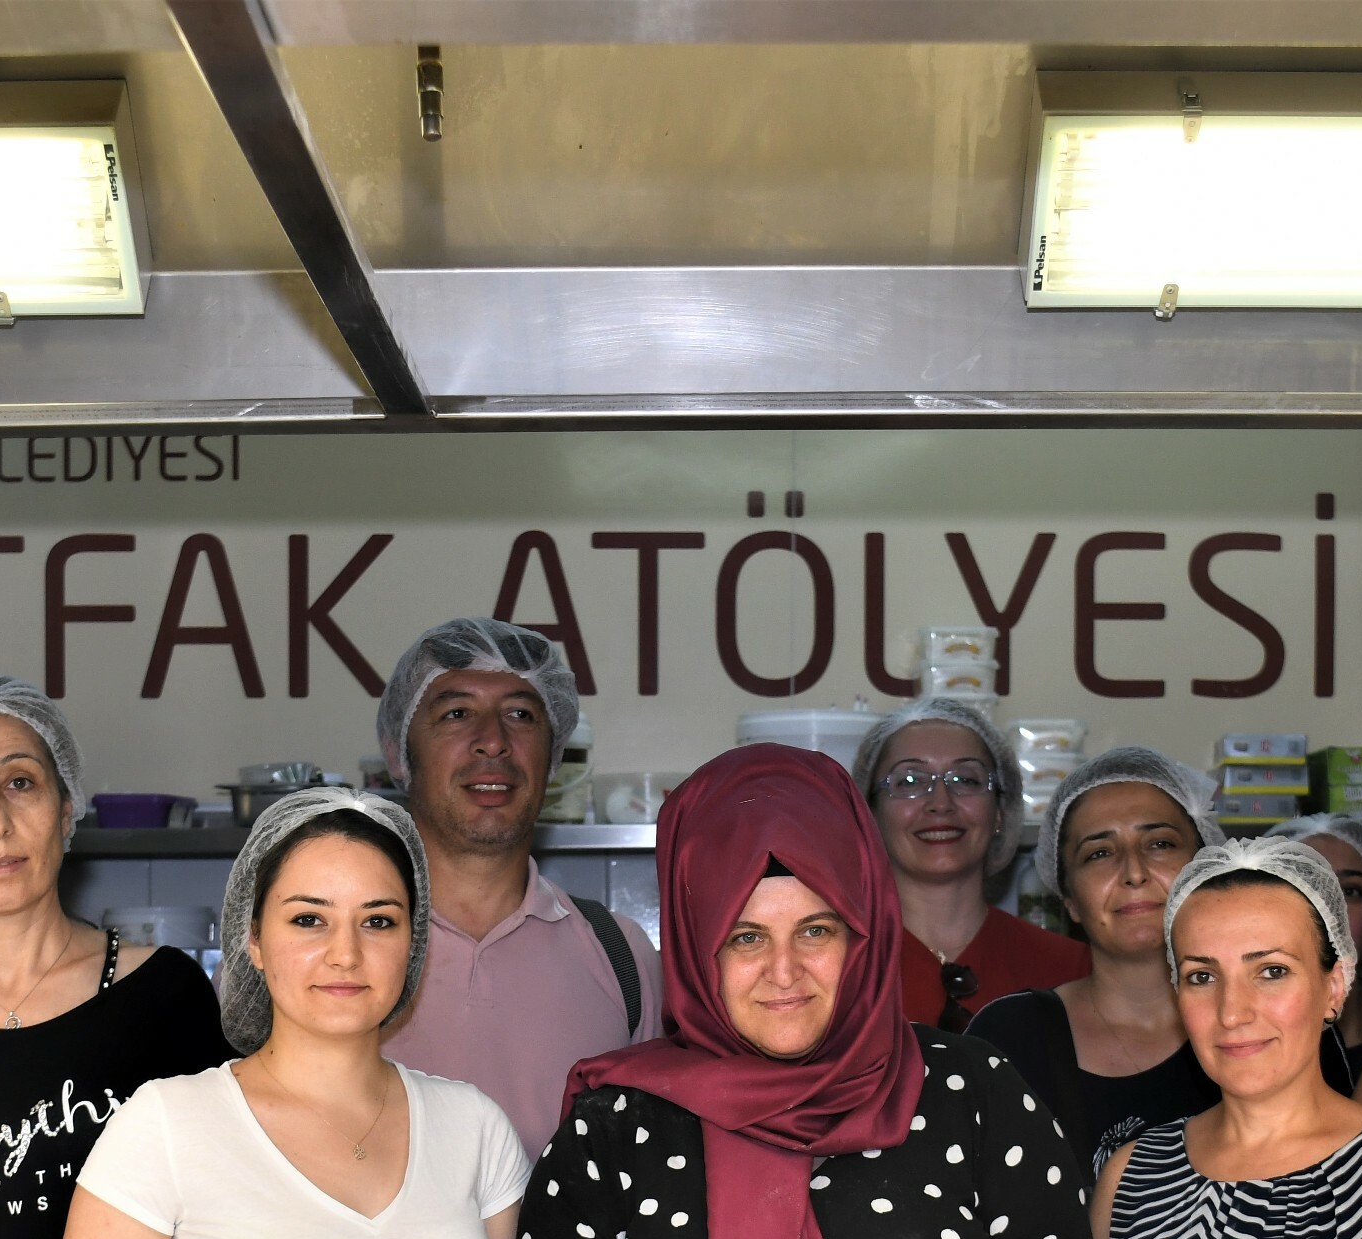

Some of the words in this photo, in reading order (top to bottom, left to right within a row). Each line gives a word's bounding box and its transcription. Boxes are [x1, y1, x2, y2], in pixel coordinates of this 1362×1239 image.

[106, 156, 119, 202] Pelsan
[1034, 235, 1047, 279] Pelsan
[492, 490, 1336, 699] ATÖLYESİ
